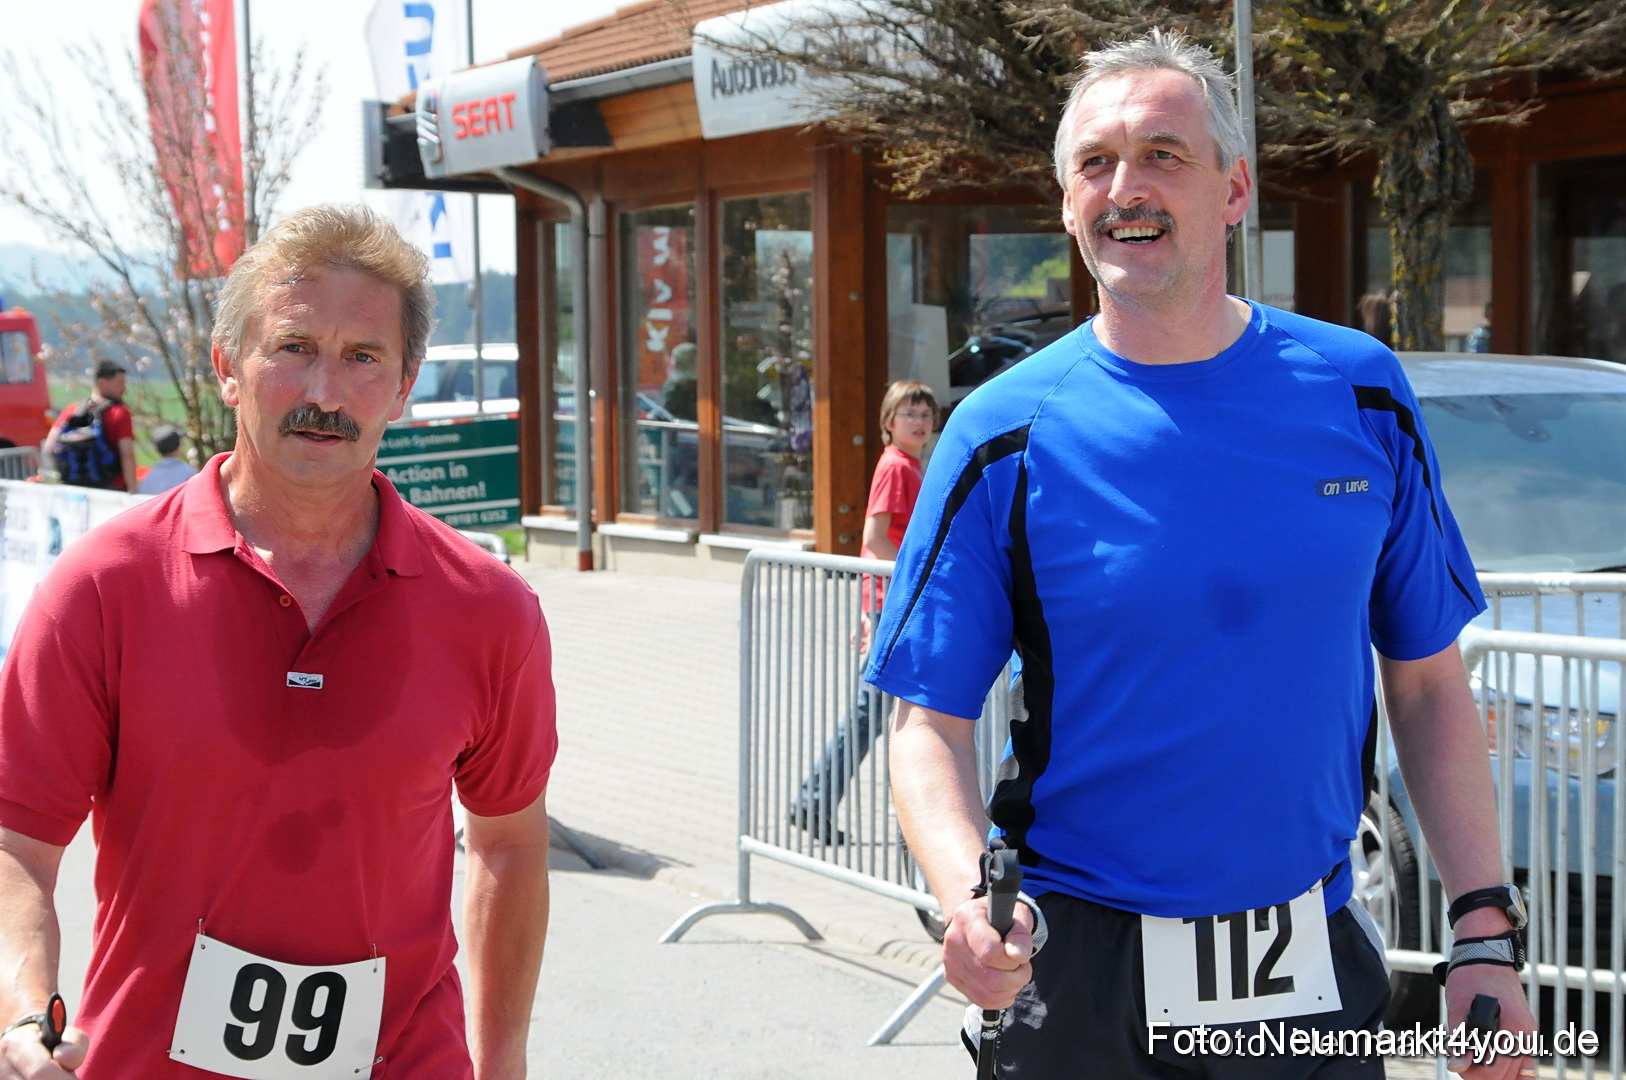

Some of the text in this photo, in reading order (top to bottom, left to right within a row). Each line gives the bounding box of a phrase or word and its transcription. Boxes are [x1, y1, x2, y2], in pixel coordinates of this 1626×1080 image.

[451, 92, 517, 139] SEAT
[386, 461, 468, 484] Action in
[410, 481, 486, 504] Bahnen!
[1182, 901, 1296, 1003] 112
[223, 962, 348, 1067] 99
